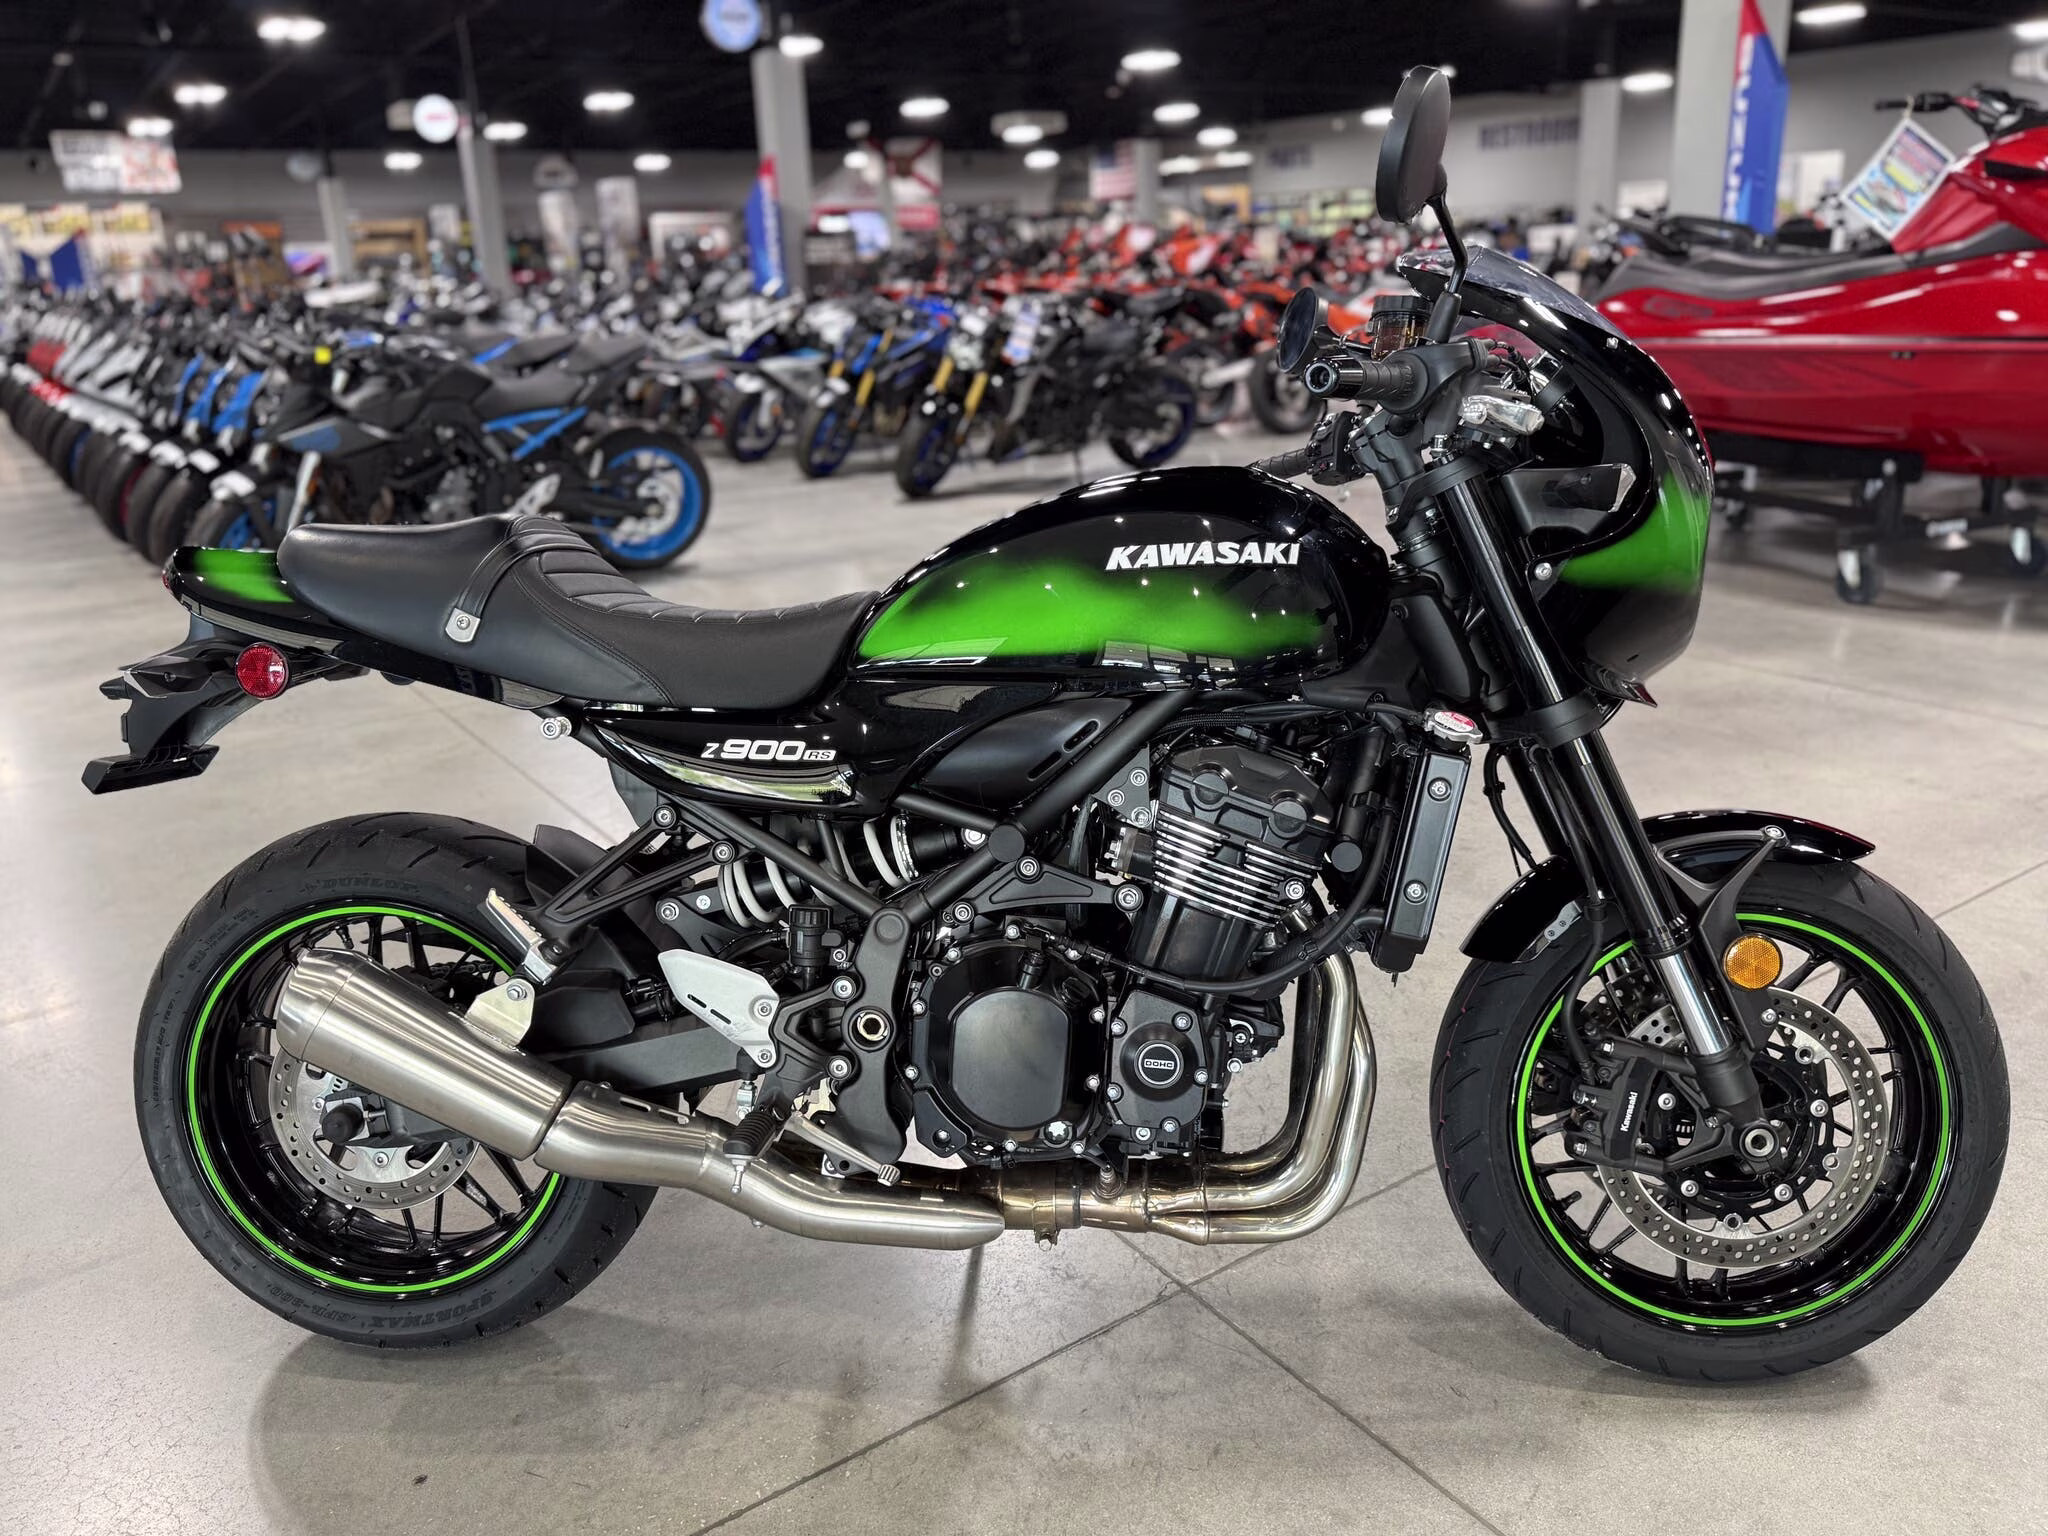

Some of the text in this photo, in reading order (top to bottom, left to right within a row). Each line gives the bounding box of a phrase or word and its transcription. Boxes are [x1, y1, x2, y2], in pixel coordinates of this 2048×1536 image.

[1105, 541, 1300, 571] KAWASAKI
[1145, 1060, 1174, 1069] DOHC
[1620, 1091, 1638, 1132] Kawasaki
